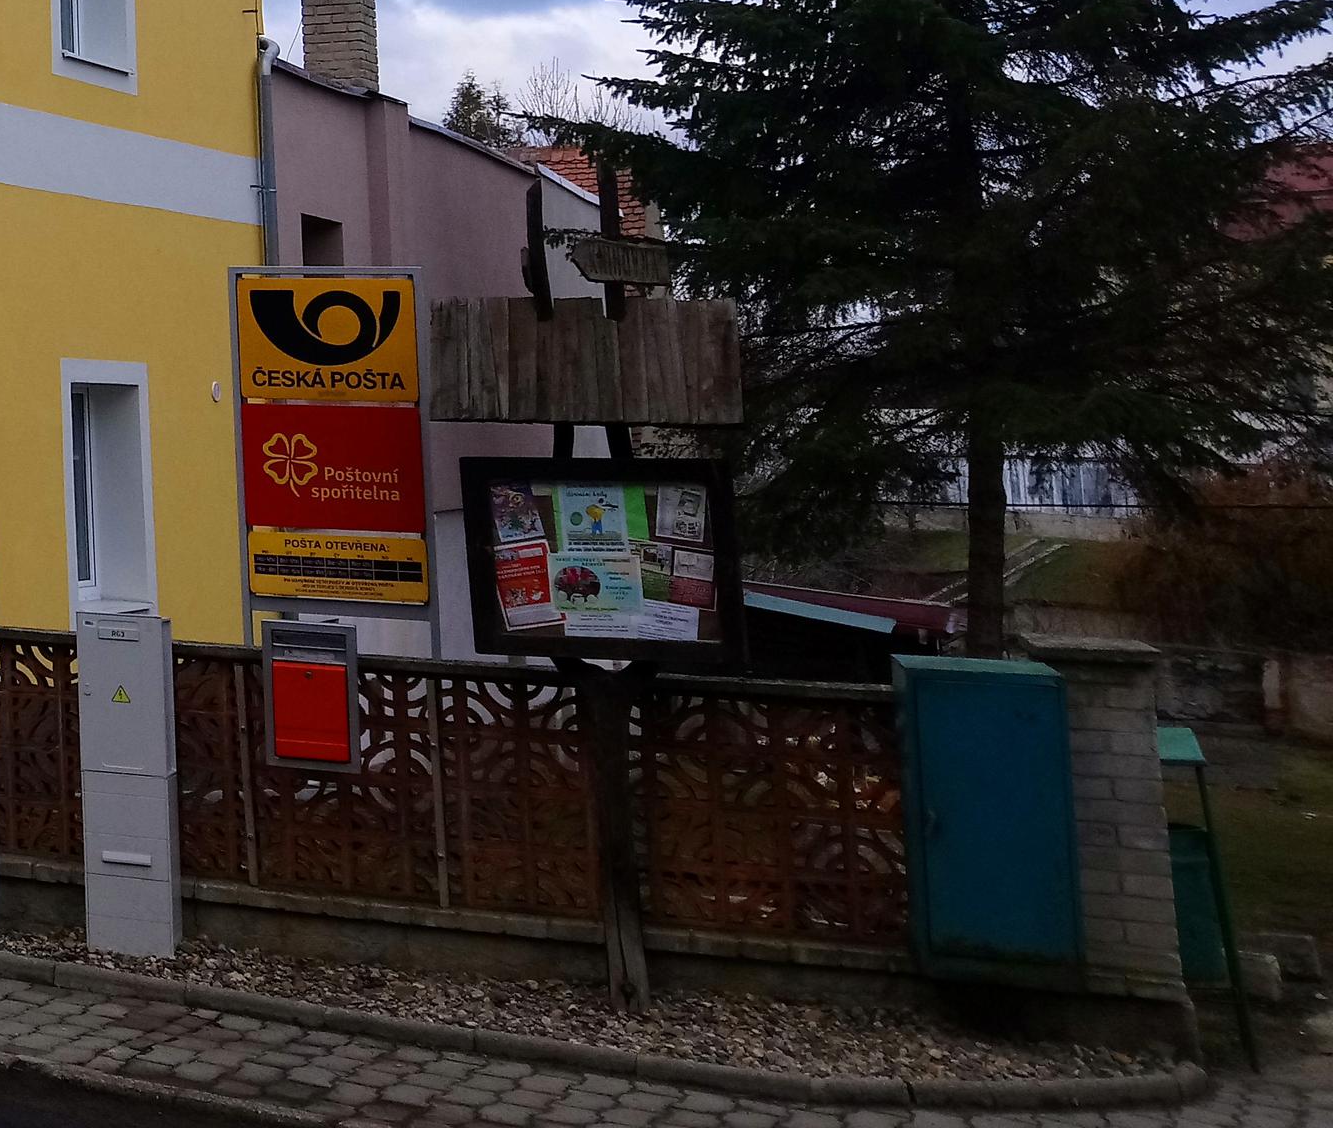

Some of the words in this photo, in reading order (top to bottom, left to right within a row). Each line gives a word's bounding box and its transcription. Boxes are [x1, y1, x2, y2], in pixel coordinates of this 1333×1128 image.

[252, 366, 326, 388] ČESKÁ
[330, 368, 406, 390] POŠTA
[324, 466, 399, 484] Poštovní
[311, 484, 400, 502] spořitelna
[284, 537, 321, 549] POŠTA
[325, 539, 390, 552] OTEVŘENA:
